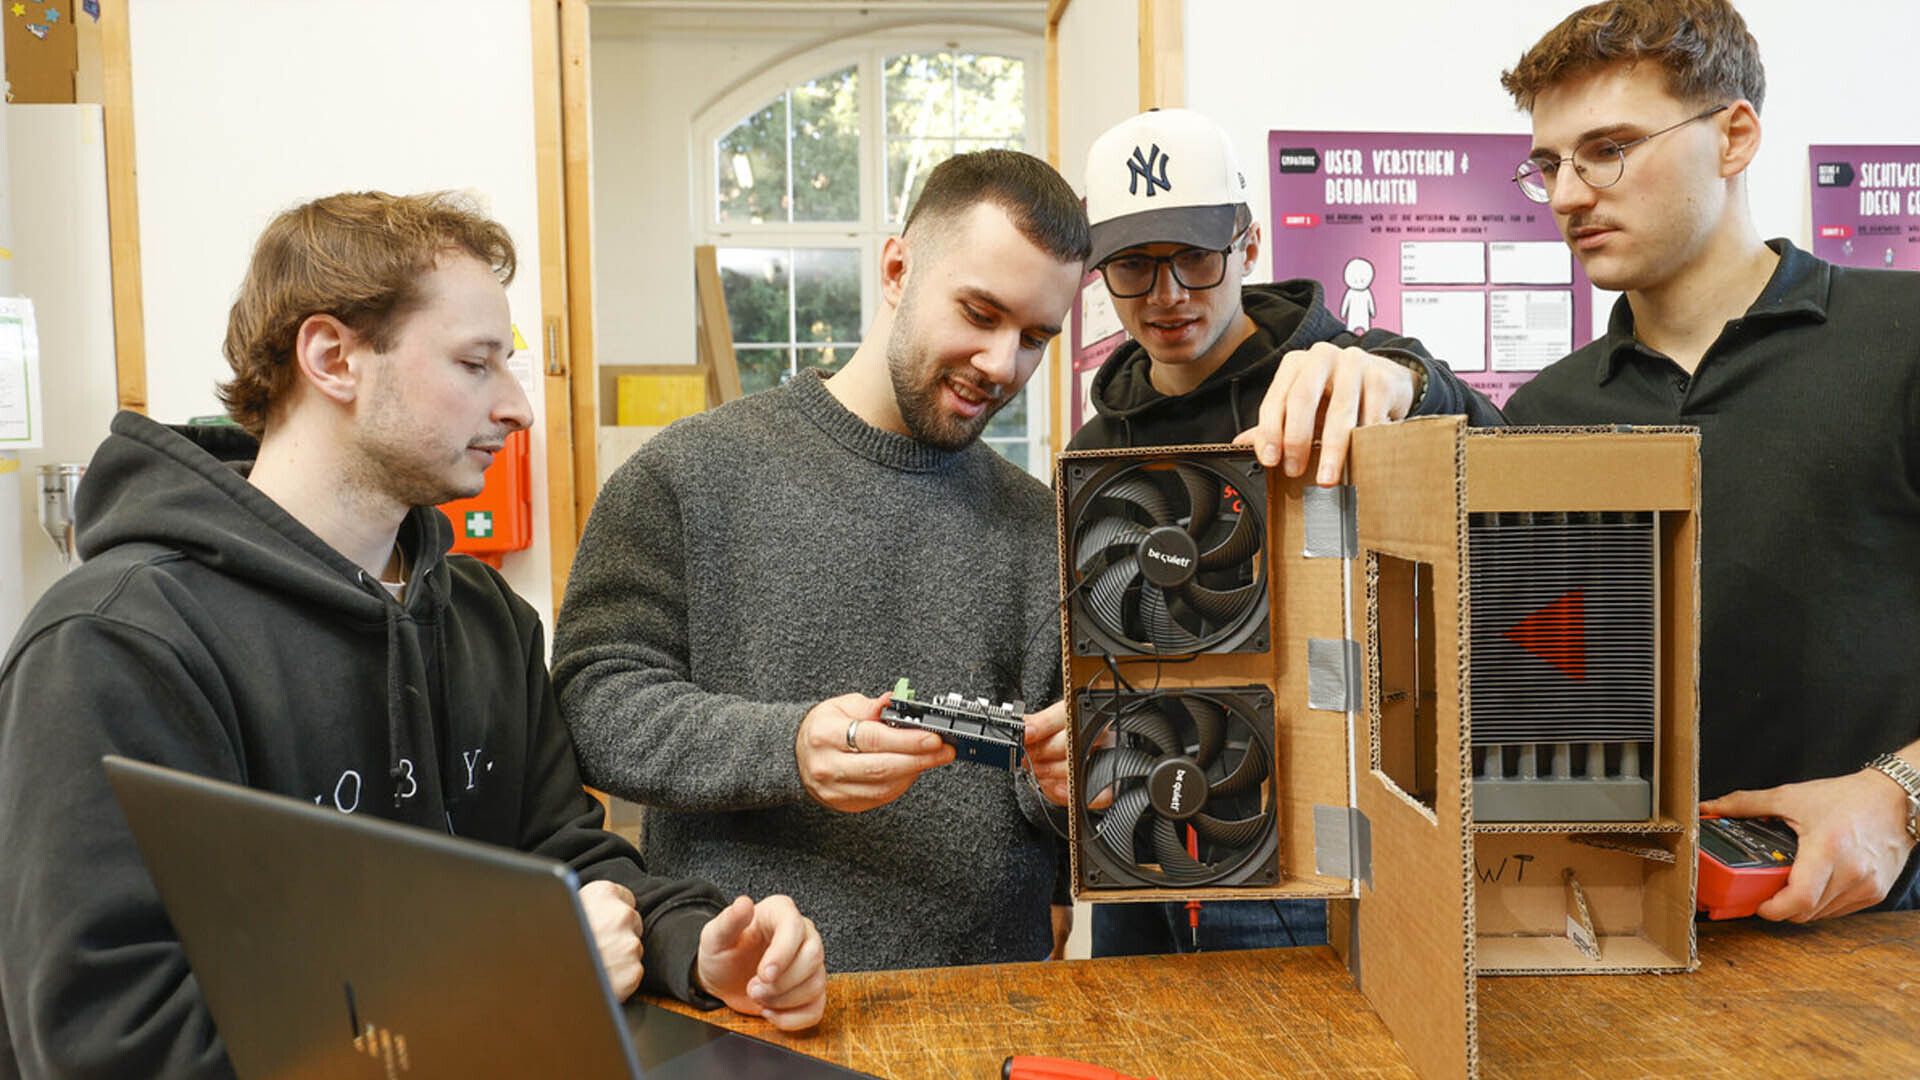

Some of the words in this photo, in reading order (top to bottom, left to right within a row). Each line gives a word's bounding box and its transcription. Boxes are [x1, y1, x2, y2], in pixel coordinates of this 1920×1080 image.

[1127, 143, 1171, 197] NY
[1325, 149, 1363, 175] USER
[1372, 149, 1454, 175] VERSTEHEN
[1325, 178, 1417, 205] BEOBACHTEN
[1860, 190, 1900, 216] IDEEN
